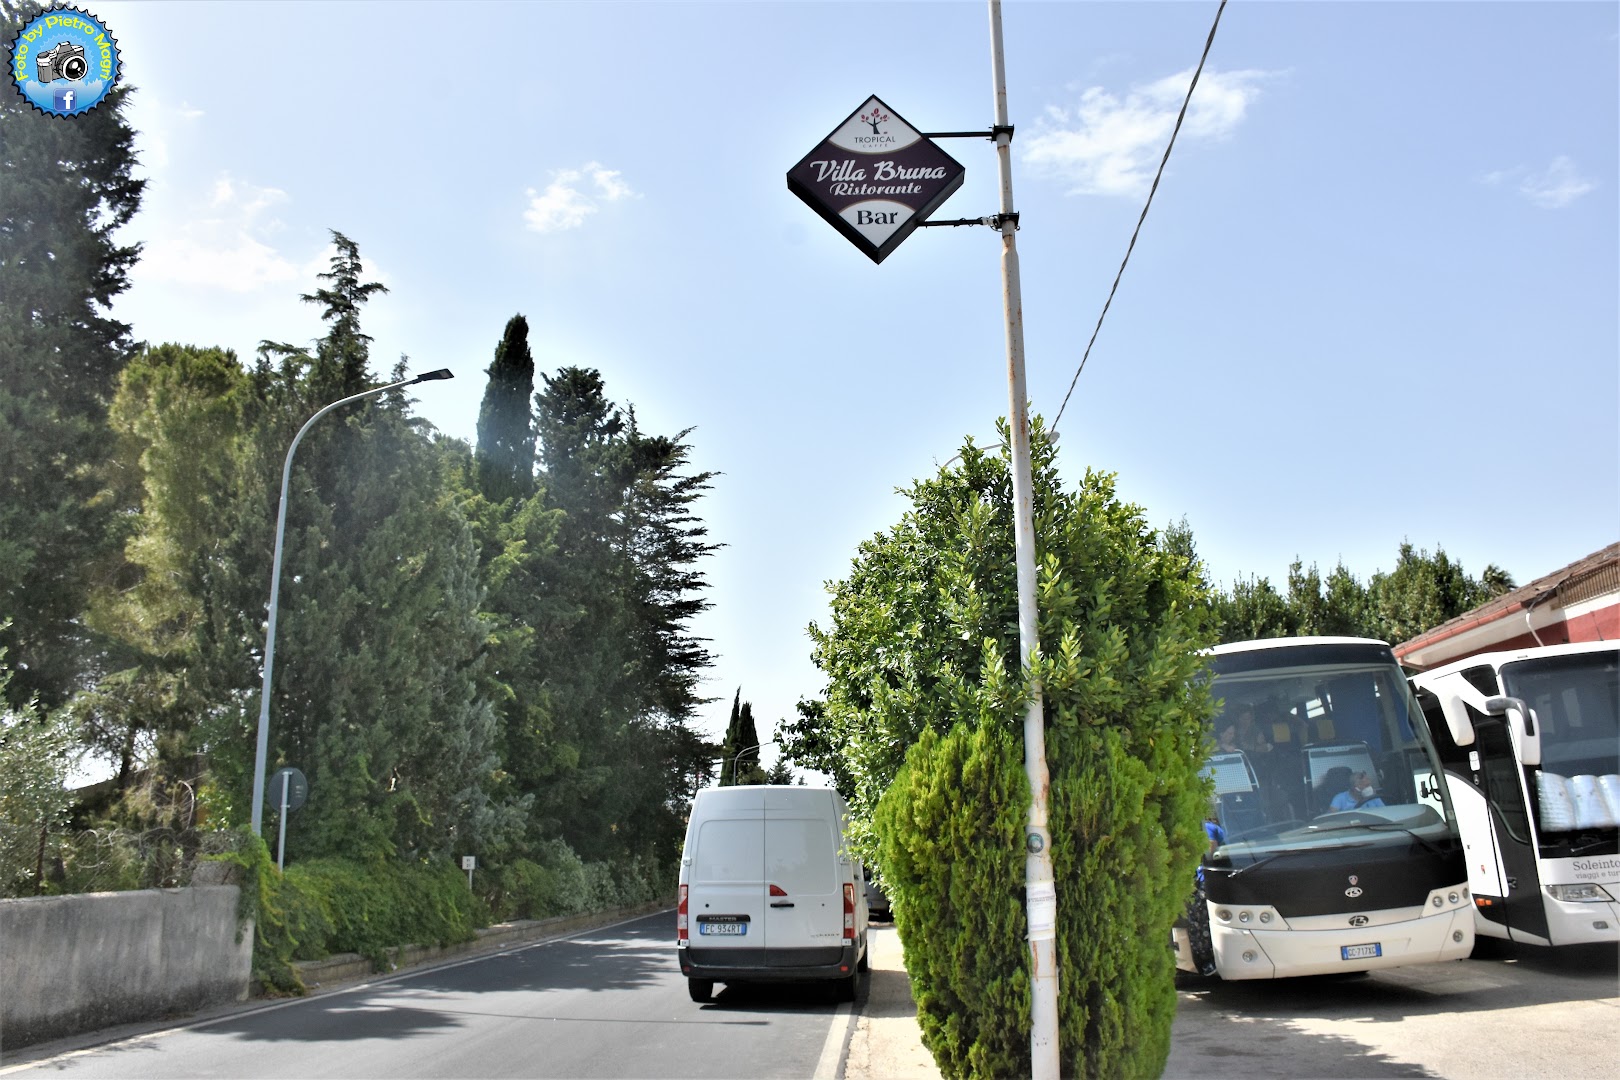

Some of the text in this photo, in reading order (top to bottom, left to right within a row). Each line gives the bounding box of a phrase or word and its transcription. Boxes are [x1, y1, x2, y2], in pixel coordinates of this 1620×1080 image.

[854, 136, 896, 144] TROPICAL
[809, 160, 947, 183] Villa Bruna
[829, 182, 923, 197] Ristorante
[857, 209, 898, 226] Bar
[1575, 871, 1600, 880] viaggi
